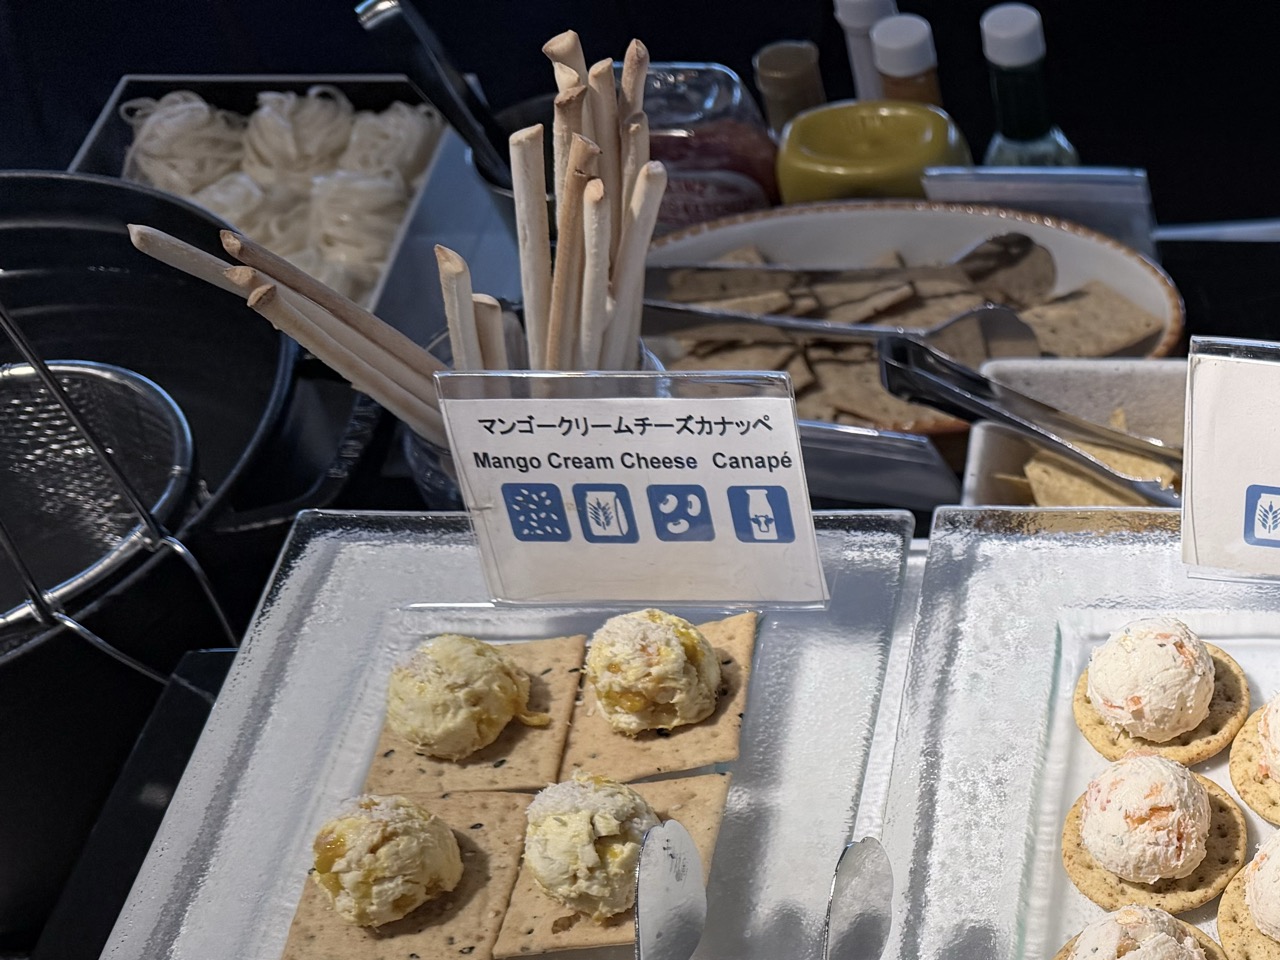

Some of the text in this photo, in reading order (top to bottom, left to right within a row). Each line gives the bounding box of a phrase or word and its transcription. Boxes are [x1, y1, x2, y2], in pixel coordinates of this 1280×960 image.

[477, 414, 773, 437] マンゴークリームチーズカナッペ
[473, 451, 792, 474] Mango Cream Cheese Canapé
